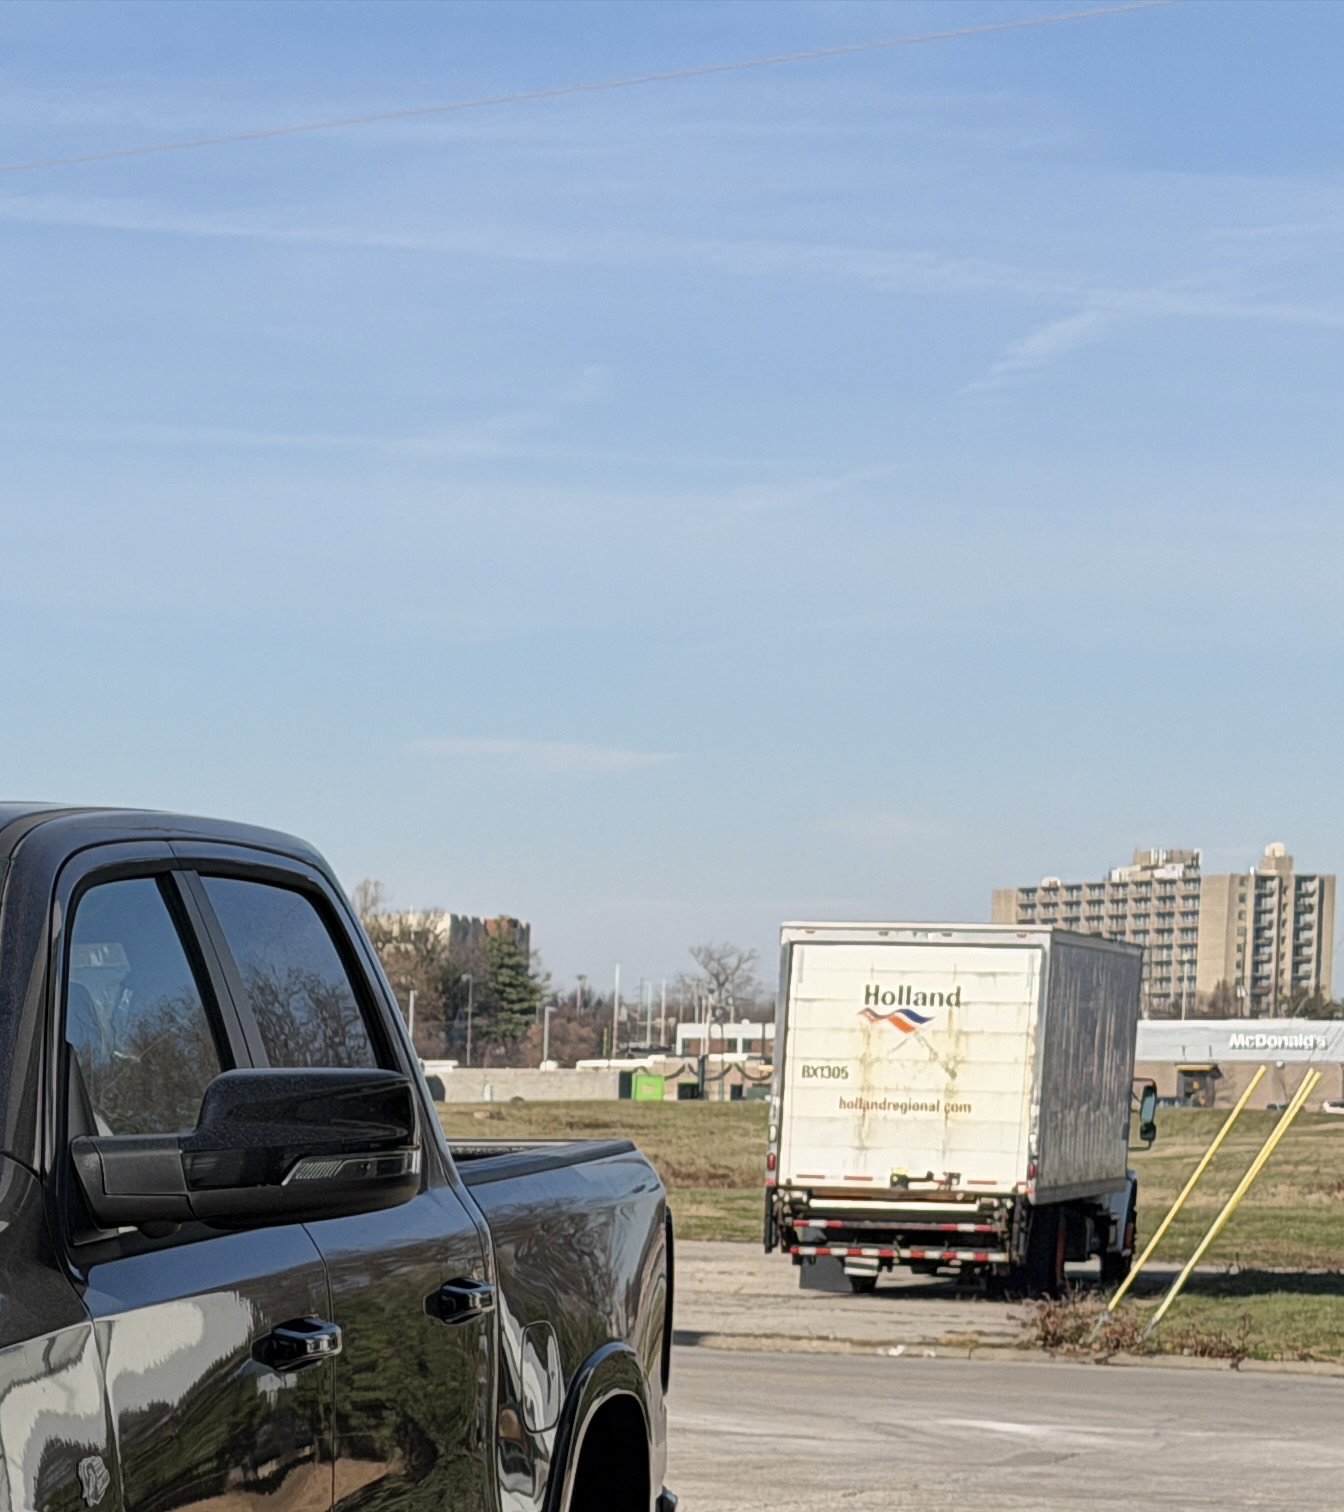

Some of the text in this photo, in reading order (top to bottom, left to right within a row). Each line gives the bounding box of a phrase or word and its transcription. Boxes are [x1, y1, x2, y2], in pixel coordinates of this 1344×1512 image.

[863, 984, 962, 1008] Holland
[1229, 1033, 1326, 1050] McDonald's
[838, 1096, 973, 1115] hollandregionalcom
